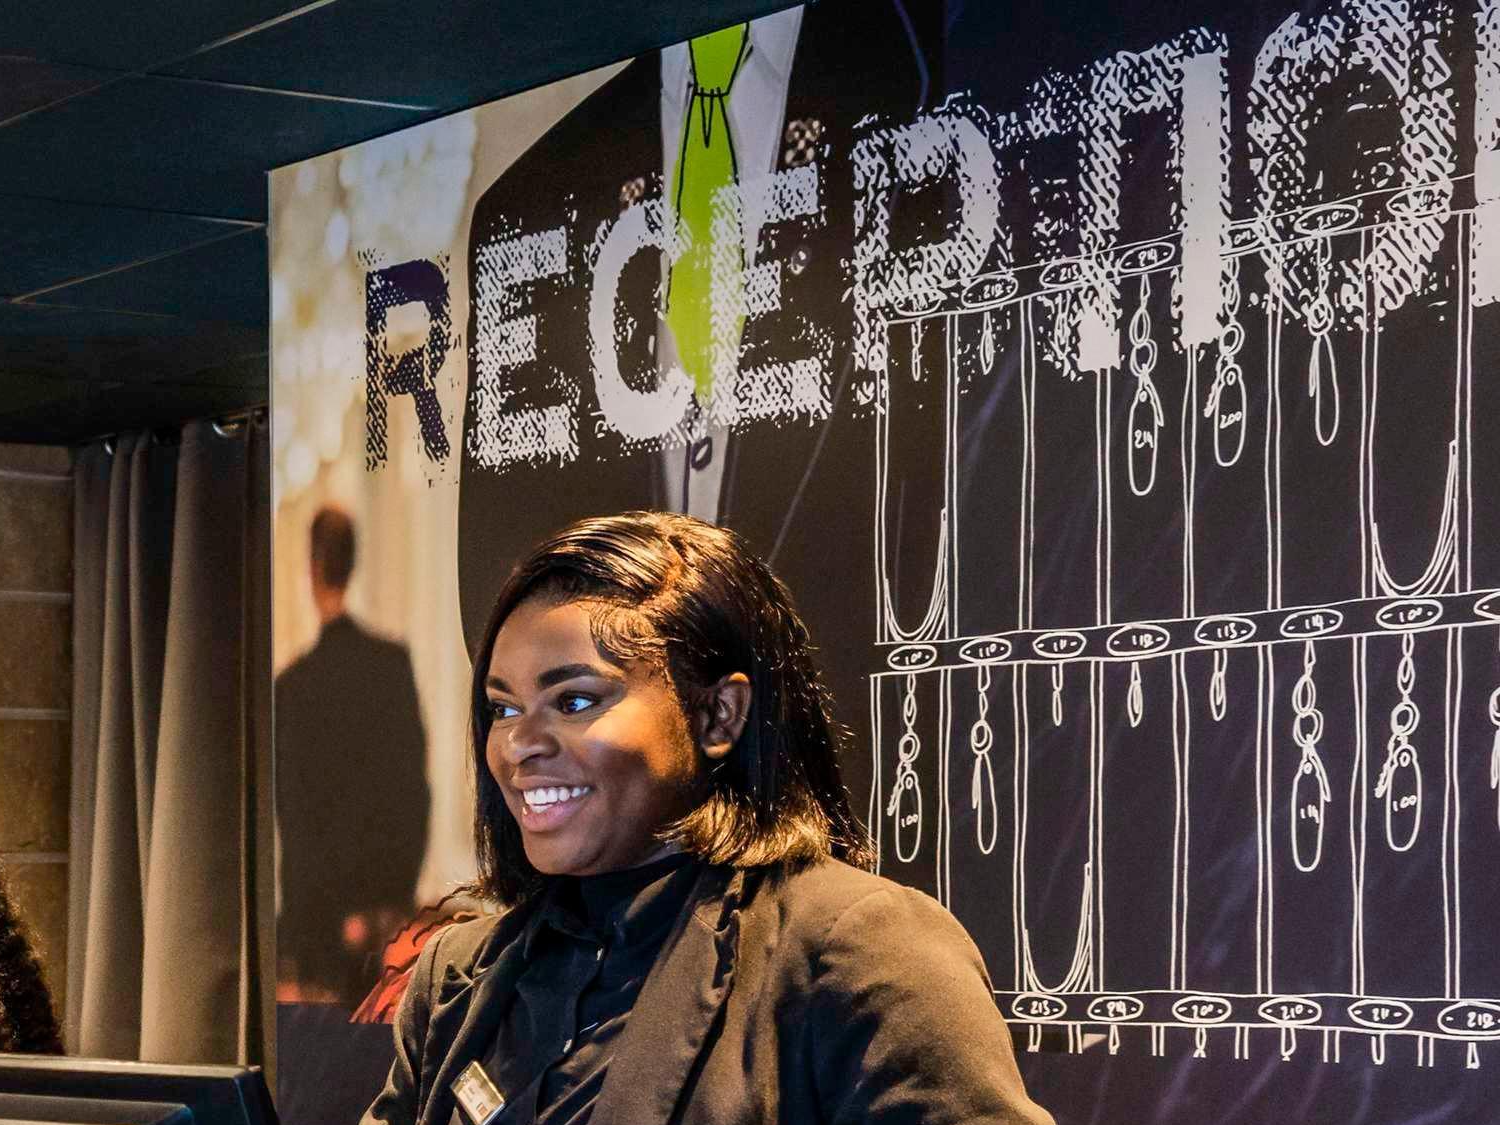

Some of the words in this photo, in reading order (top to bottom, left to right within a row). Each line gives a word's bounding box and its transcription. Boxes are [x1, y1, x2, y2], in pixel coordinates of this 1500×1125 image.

[360, 0, 1500, 480] RECEPTIO
[1219, 411, 1243, 429] 200
[979, 642, 997, 658] 110
[1392, 794, 1418, 812] 100
[901, 813, 919, 829] 100
